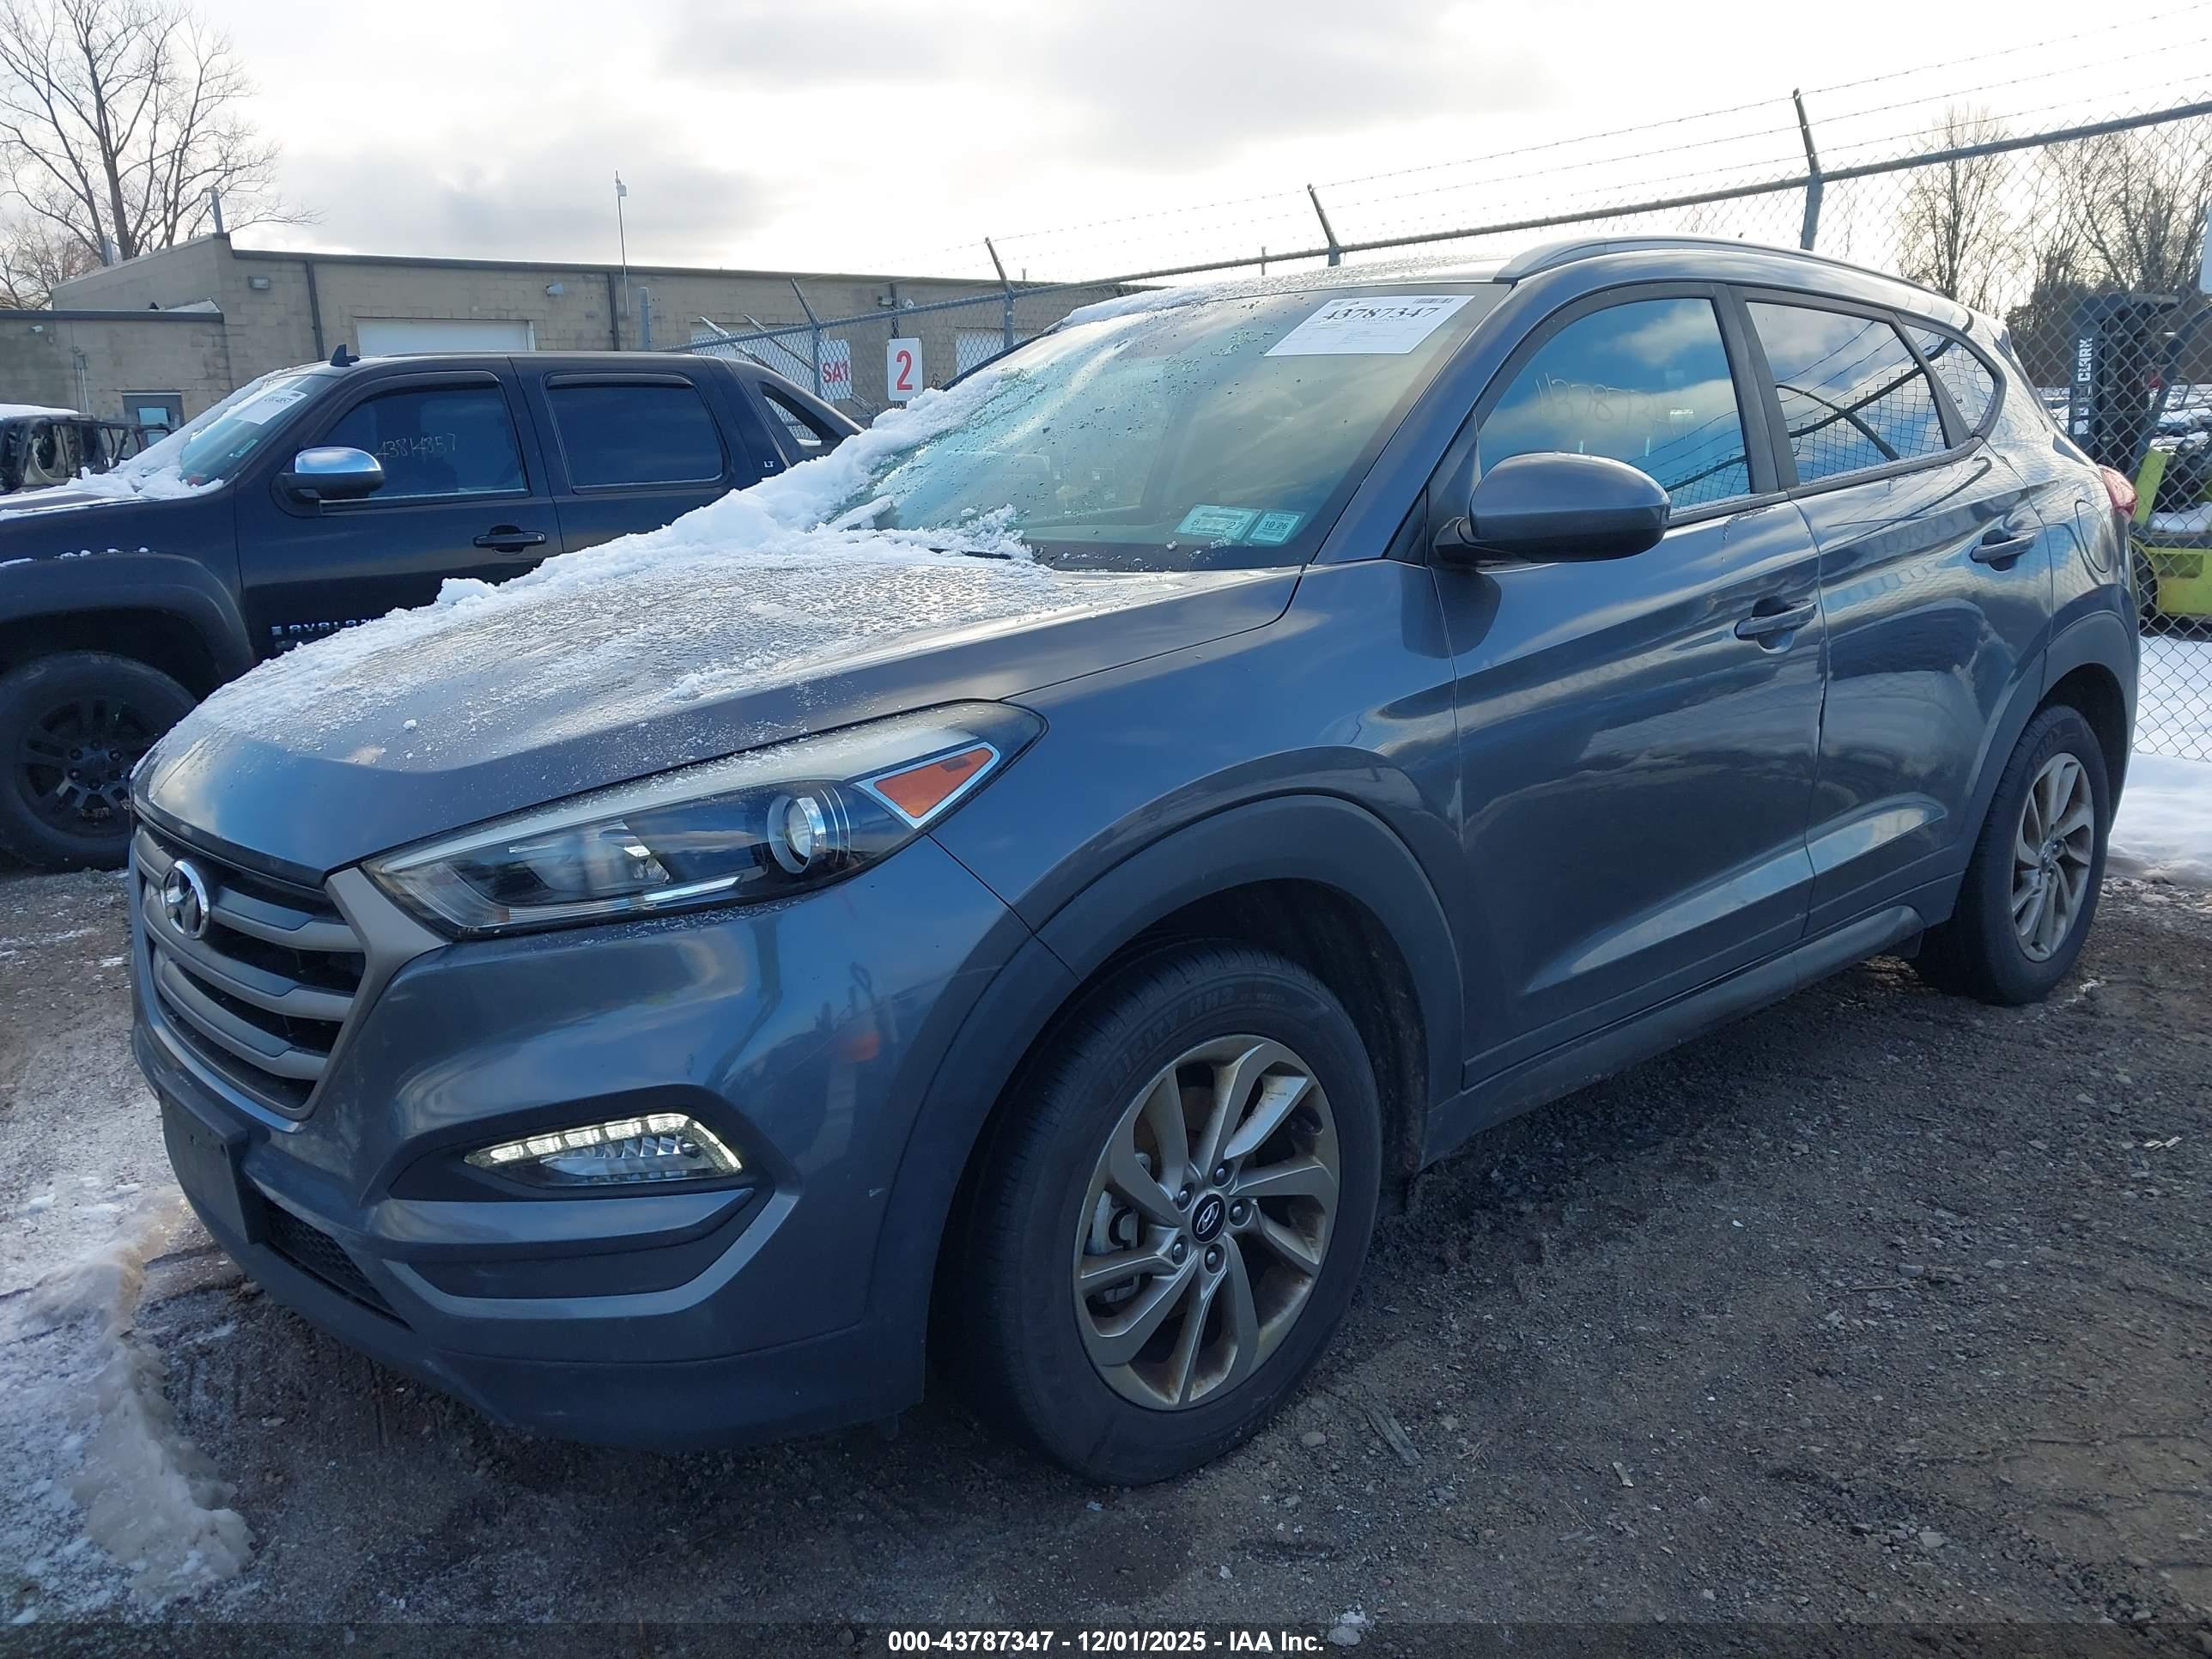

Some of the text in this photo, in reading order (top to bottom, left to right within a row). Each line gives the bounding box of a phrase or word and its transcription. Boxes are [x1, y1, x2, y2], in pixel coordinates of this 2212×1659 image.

[1322, 306, 1441, 321] 43787347
[896, 349, 914, 391] 2
[374, 433, 456, 462] 43814857
[1225, 520, 1245, 531] 27
[1264, 520, 1289, 530] 10 26
